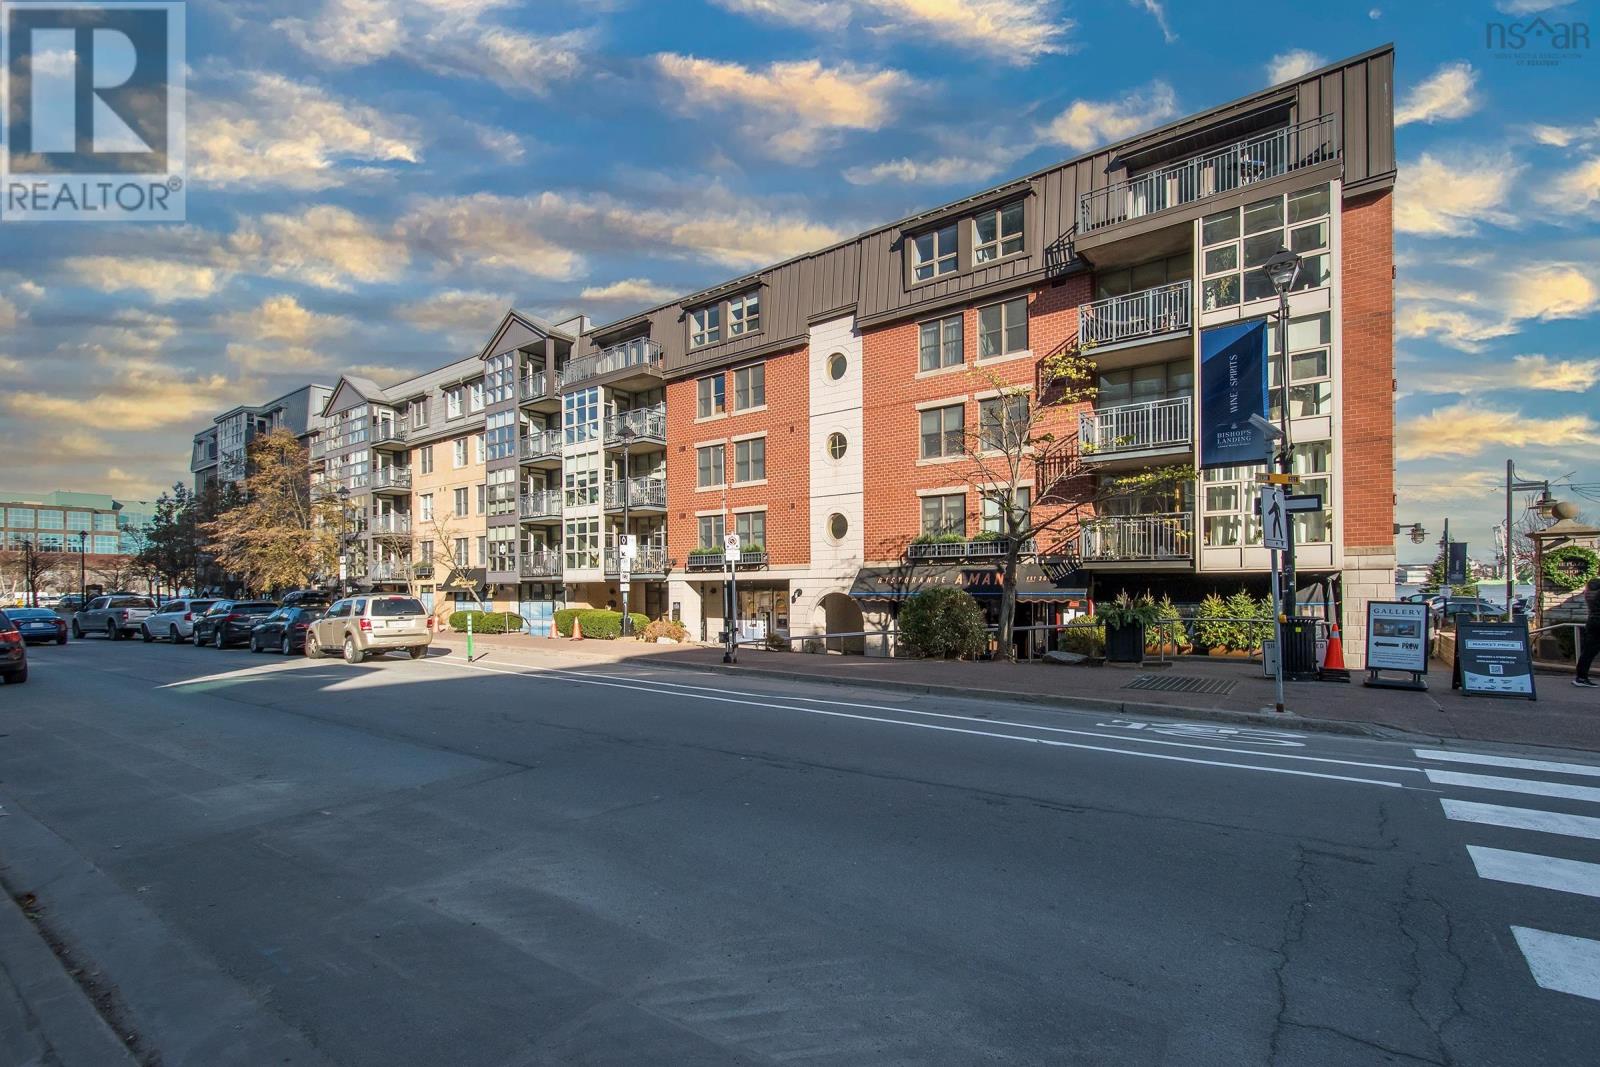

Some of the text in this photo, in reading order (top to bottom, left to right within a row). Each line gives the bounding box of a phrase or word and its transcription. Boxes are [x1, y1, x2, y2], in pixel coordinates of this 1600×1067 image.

[1229, 354, 1238, 386] SPIRITS
[1217, 430, 1252, 438] BISHOP'S
[1217, 436, 1252, 444] LANDING
[877, 576, 947, 584] RISTORANTE
[1373, 608, 1422, 616] GALLERY
